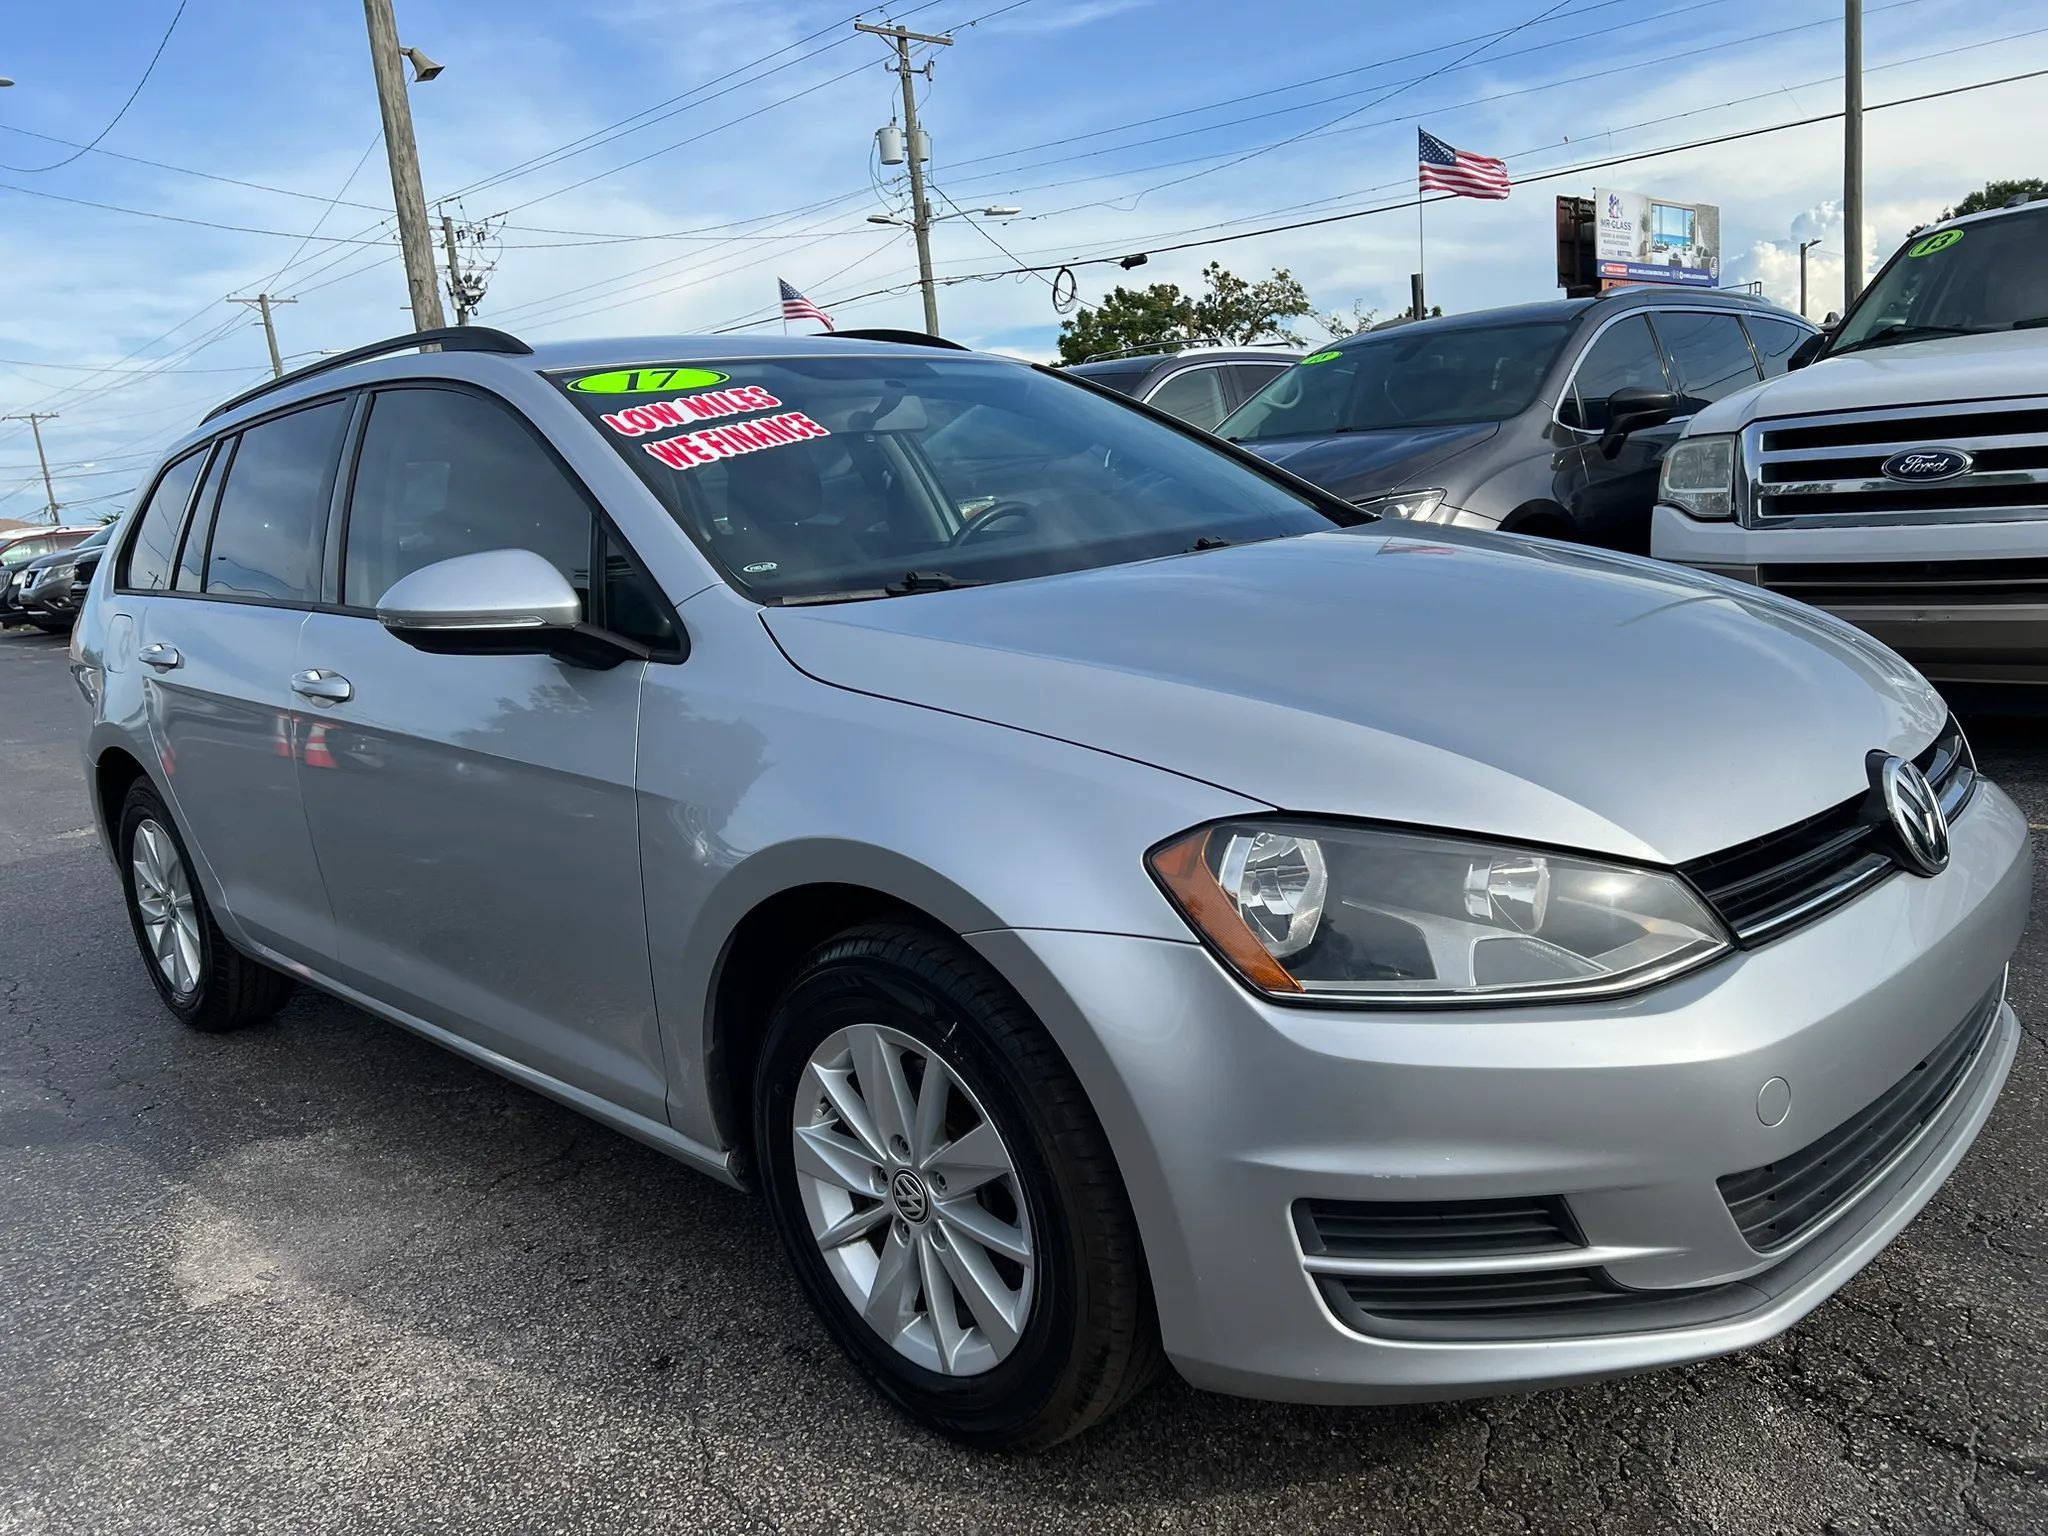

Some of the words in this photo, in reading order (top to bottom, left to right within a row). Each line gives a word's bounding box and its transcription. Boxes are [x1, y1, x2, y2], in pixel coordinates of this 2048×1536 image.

[624, 369, 679, 392] 17
[603, 402, 685, 435] LOW
[682, 386, 780, 418] MILES
[648, 434, 716, 468] WE
[697, 412, 828, 455] FINANCE
[1900, 454, 1949, 474] Ford
